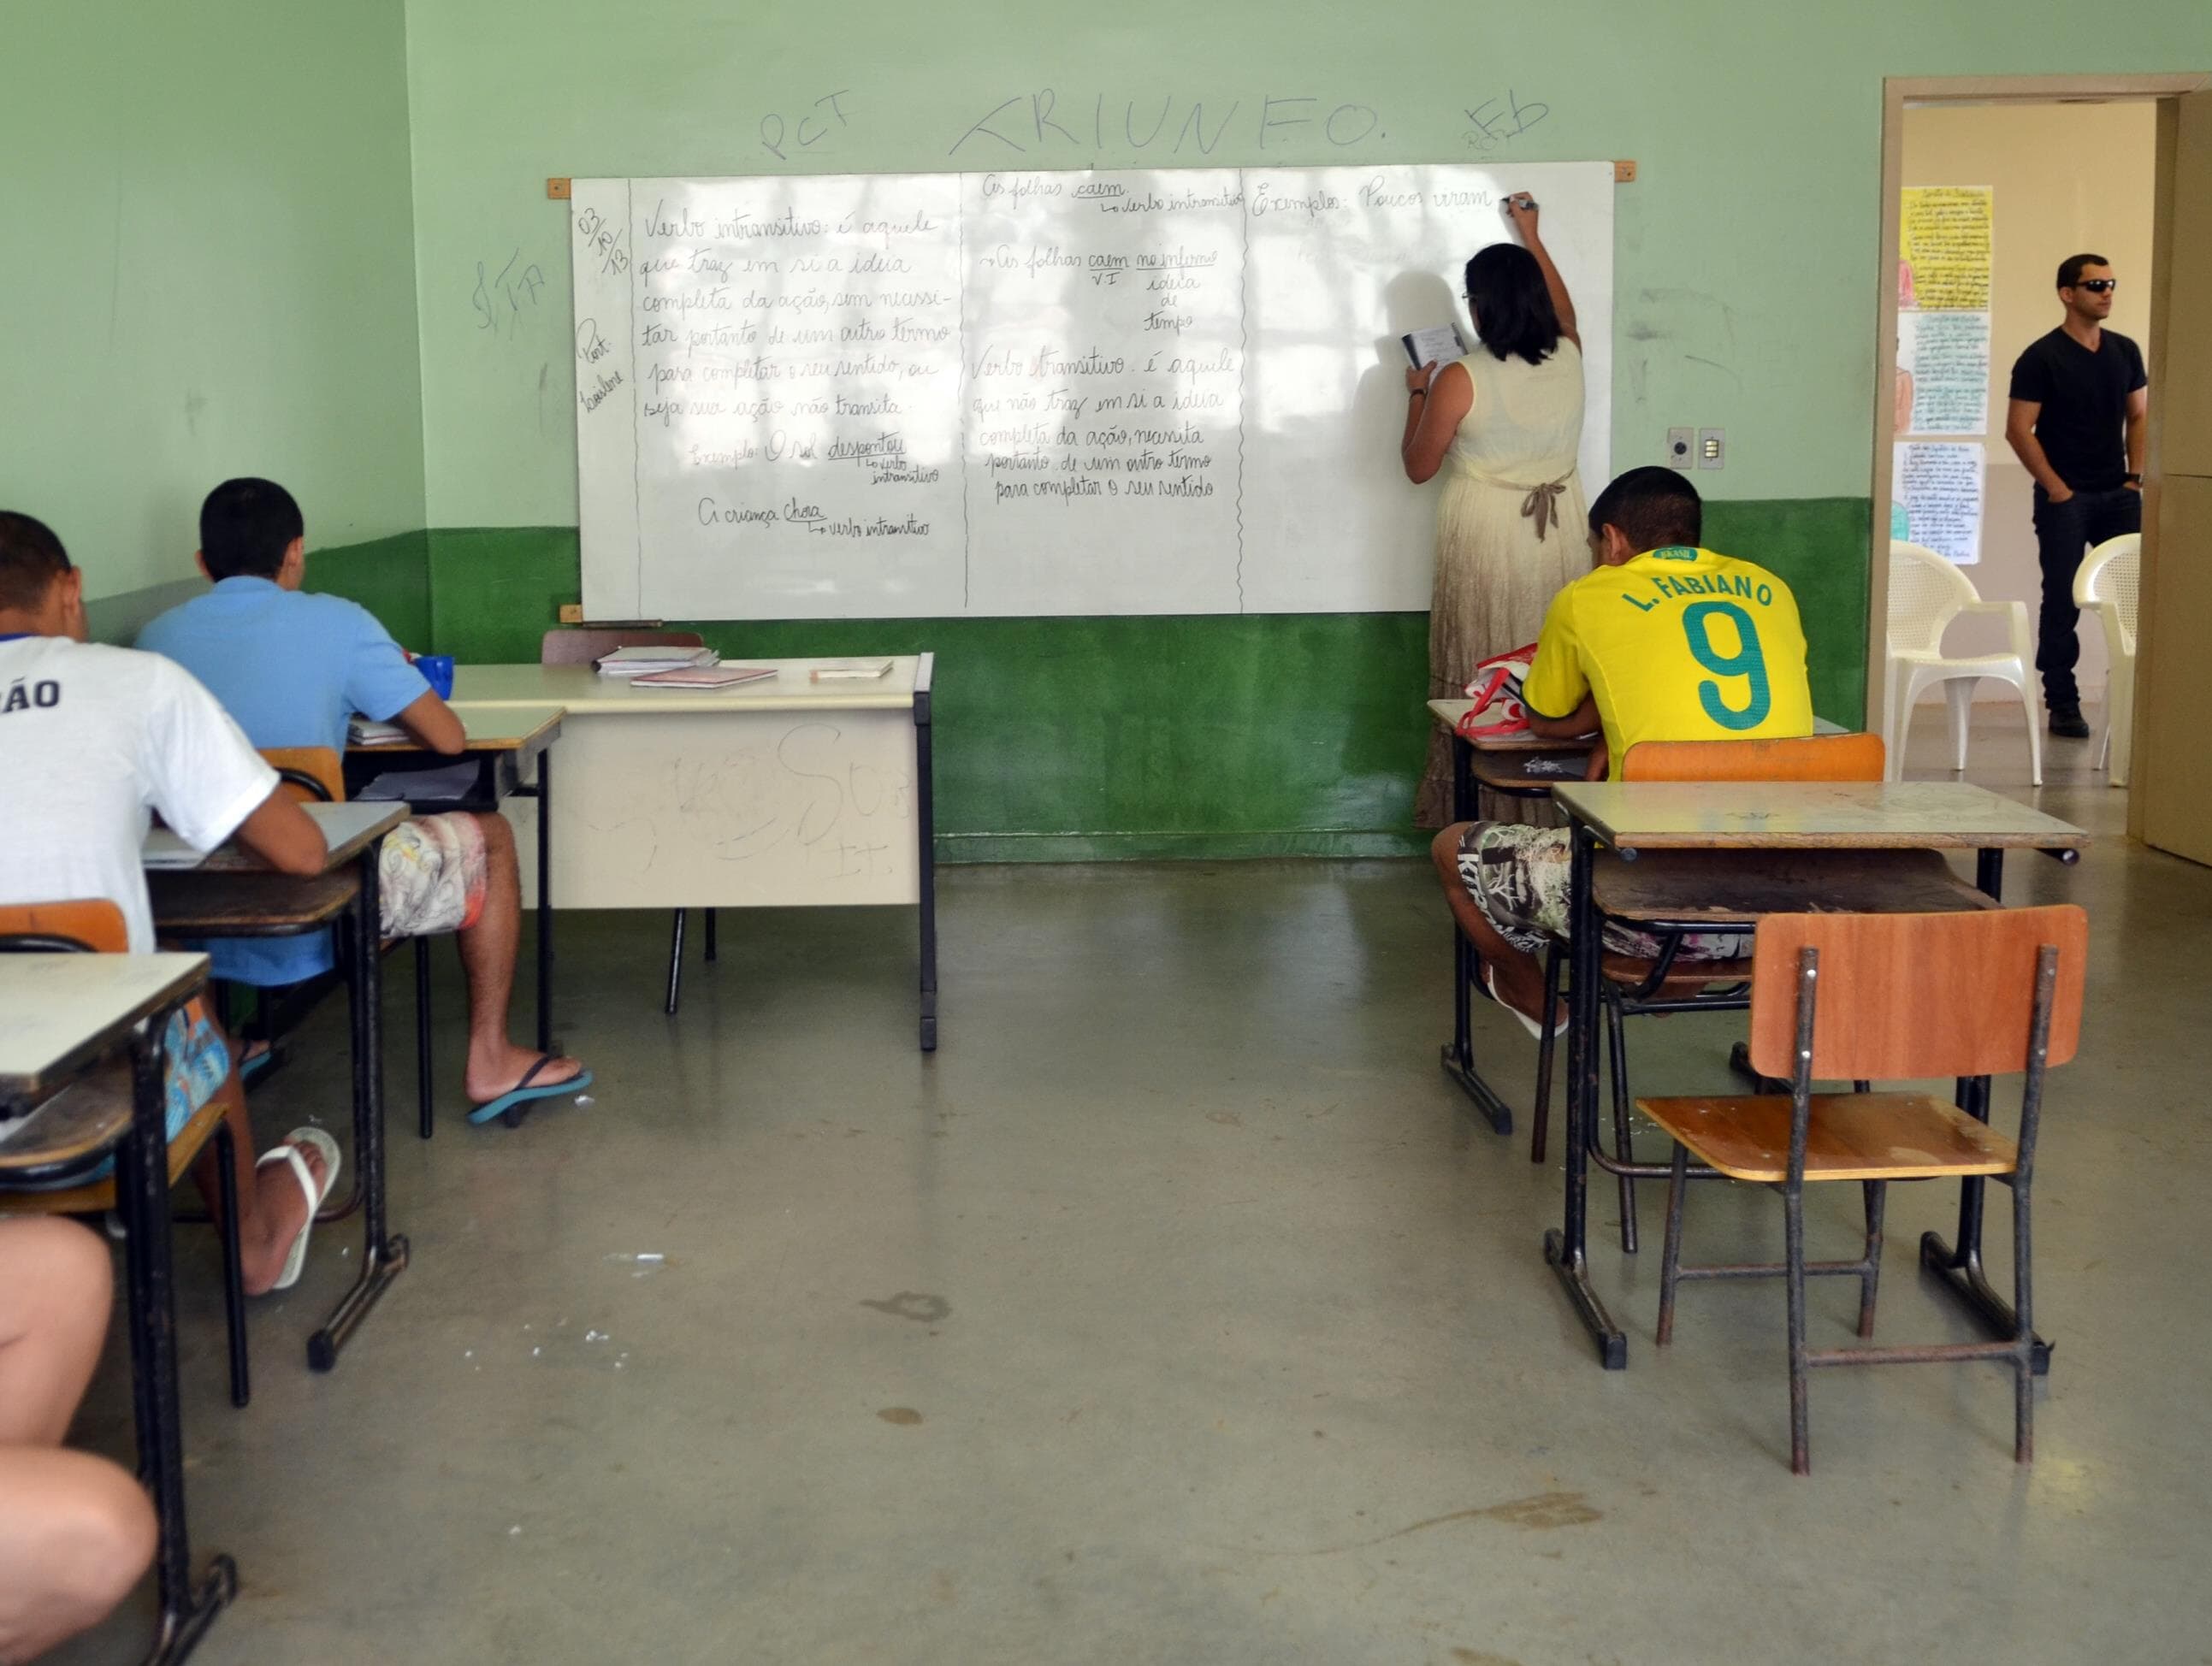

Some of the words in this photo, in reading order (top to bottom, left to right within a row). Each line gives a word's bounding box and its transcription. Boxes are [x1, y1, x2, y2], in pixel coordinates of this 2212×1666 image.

[983, 174, 1005, 197] As
[1009, 177, 1062, 210] folhas
[1359, 174, 1423, 207] Poucos
[645, 199, 706, 237] Verbo
[836, 210, 856, 233] é
[862, 210, 938, 250] aquele
[640, 258, 680, 287] que
[687, 248, 733, 283] traz
[742, 260, 779, 274] em
[790, 254, 822, 274] si
[827, 258, 843, 273] a
[1025, 245, 1082, 279] folhas
[1089, 254, 1129, 267] caem
[642, 287, 732, 321] completa
[742, 290, 773, 309] da
[833, 292, 873, 308] sem
[1161, 294, 1178, 308] de
[642, 323, 677, 346] tar
[685, 319, 757, 358] portanto
[769, 325, 785, 346] de
[792, 328, 833, 345] um
[840, 317, 885, 342] outro
[891, 316, 951, 342] termo
[1144, 310, 1193, 335] tempo
[648, 363, 692, 395] para
[702, 356, 781, 390] completar
[789, 365, 796, 379] o
[801, 363, 830, 376] seu
[908, 364, 939, 376] ou
[972, 344, 1023, 379] Verbo
[1144, 351, 1163, 372] é
[1168, 347, 1234, 385] aquele
[643, 397, 684, 428] seja
[689, 402, 726, 416] sua
[732, 397, 784, 423] ação
[791, 397, 829, 416] não
[973, 398, 1000, 422] que
[1006, 392, 1037, 411] não
[1044, 388, 1088, 420] traz
[1095, 396, 1123, 412] em
[1127, 388, 1148, 409] si
[1153, 395, 1166, 408] a
[765, 429, 787, 462] O
[789, 432, 819, 459] sol
[827, 431, 903, 467] despontou
[979, 422, 1050, 448] completa
[1056, 426, 1078, 446] da
[1134, 420, 1204, 445] necessita
[871, 464, 939, 485] intransitivo
[1061, 452, 1076, 471] de
[1084, 456, 1121, 470] um
[1127, 449, 1163, 471] outro
[1168, 448, 1212, 470] termo
[995, 481, 1030, 505] para
[1033, 475, 1102, 506] completar
[1125, 480, 1155, 496] seu
[1159, 474, 1213, 498] sentido
[698, 497, 719, 526] A
[725, 502, 779, 529] criança
[829, 517, 861, 538] verbo
[866, 513, 930, 537] intransitivo
[1622, 593, 1659, 611] L.
[1652, 574, 1772, 606] FABIANO
[1682, 601, 1771, 730] 9
[0, 676, 61, 713] ÃO
